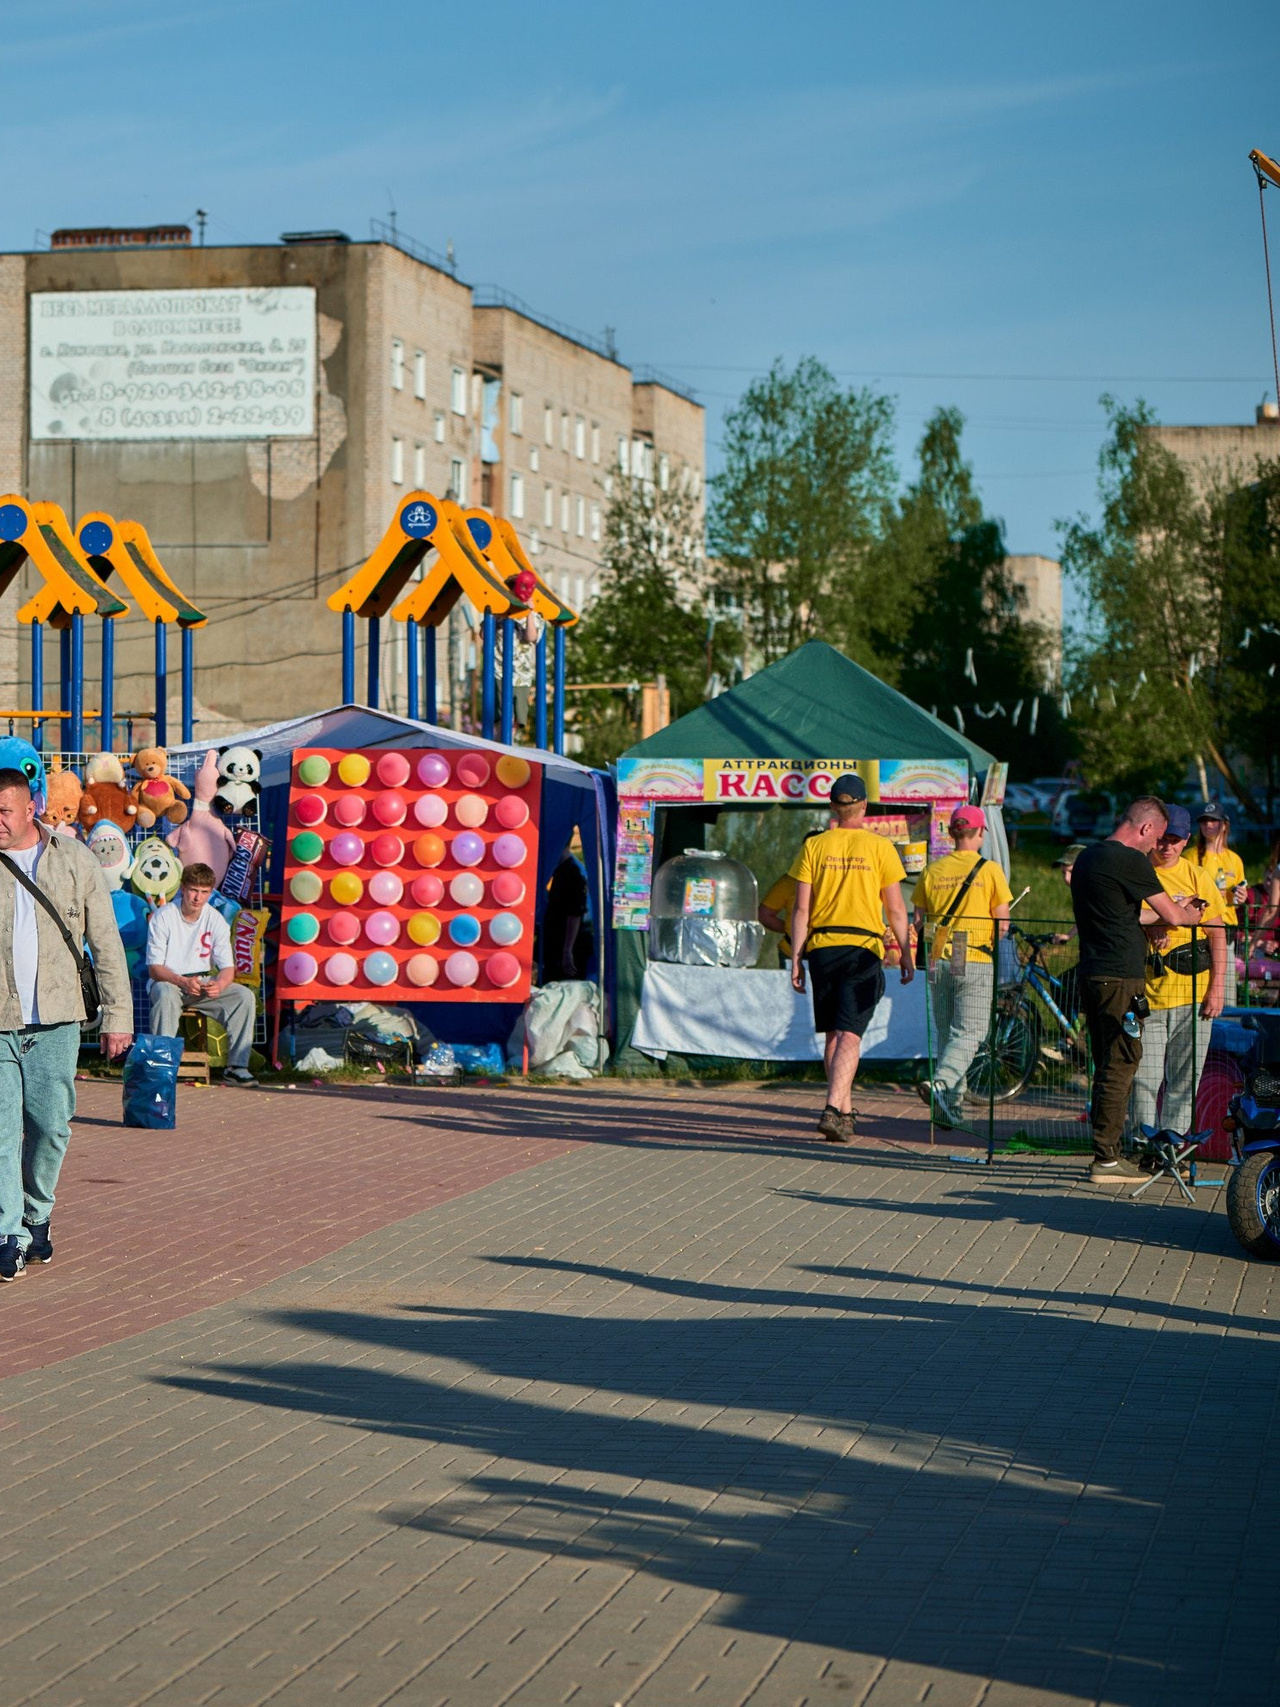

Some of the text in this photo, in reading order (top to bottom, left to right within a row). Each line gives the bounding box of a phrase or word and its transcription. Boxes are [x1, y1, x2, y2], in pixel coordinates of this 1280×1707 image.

[40, 295, 241, 318] ВЕСЬ МЕТАЛЛОПРОКАТ
[127, 319, 188, 337] ОДНОМ
[190, 317, 241, 335] МЕСТЕ
[100, 379, 305, 403] 8-920-342-38-08
[100, 406, 116, 427] 8
[206, 404, 305, 427] 2-22-39
[722, 760, 858, 771] АТТРАКЦИОНЫ
[718, 773, 833, 799] КАСС
[221, 844, 252, 900] SNICKERS
[235, 921, 257, 975] Nuts
